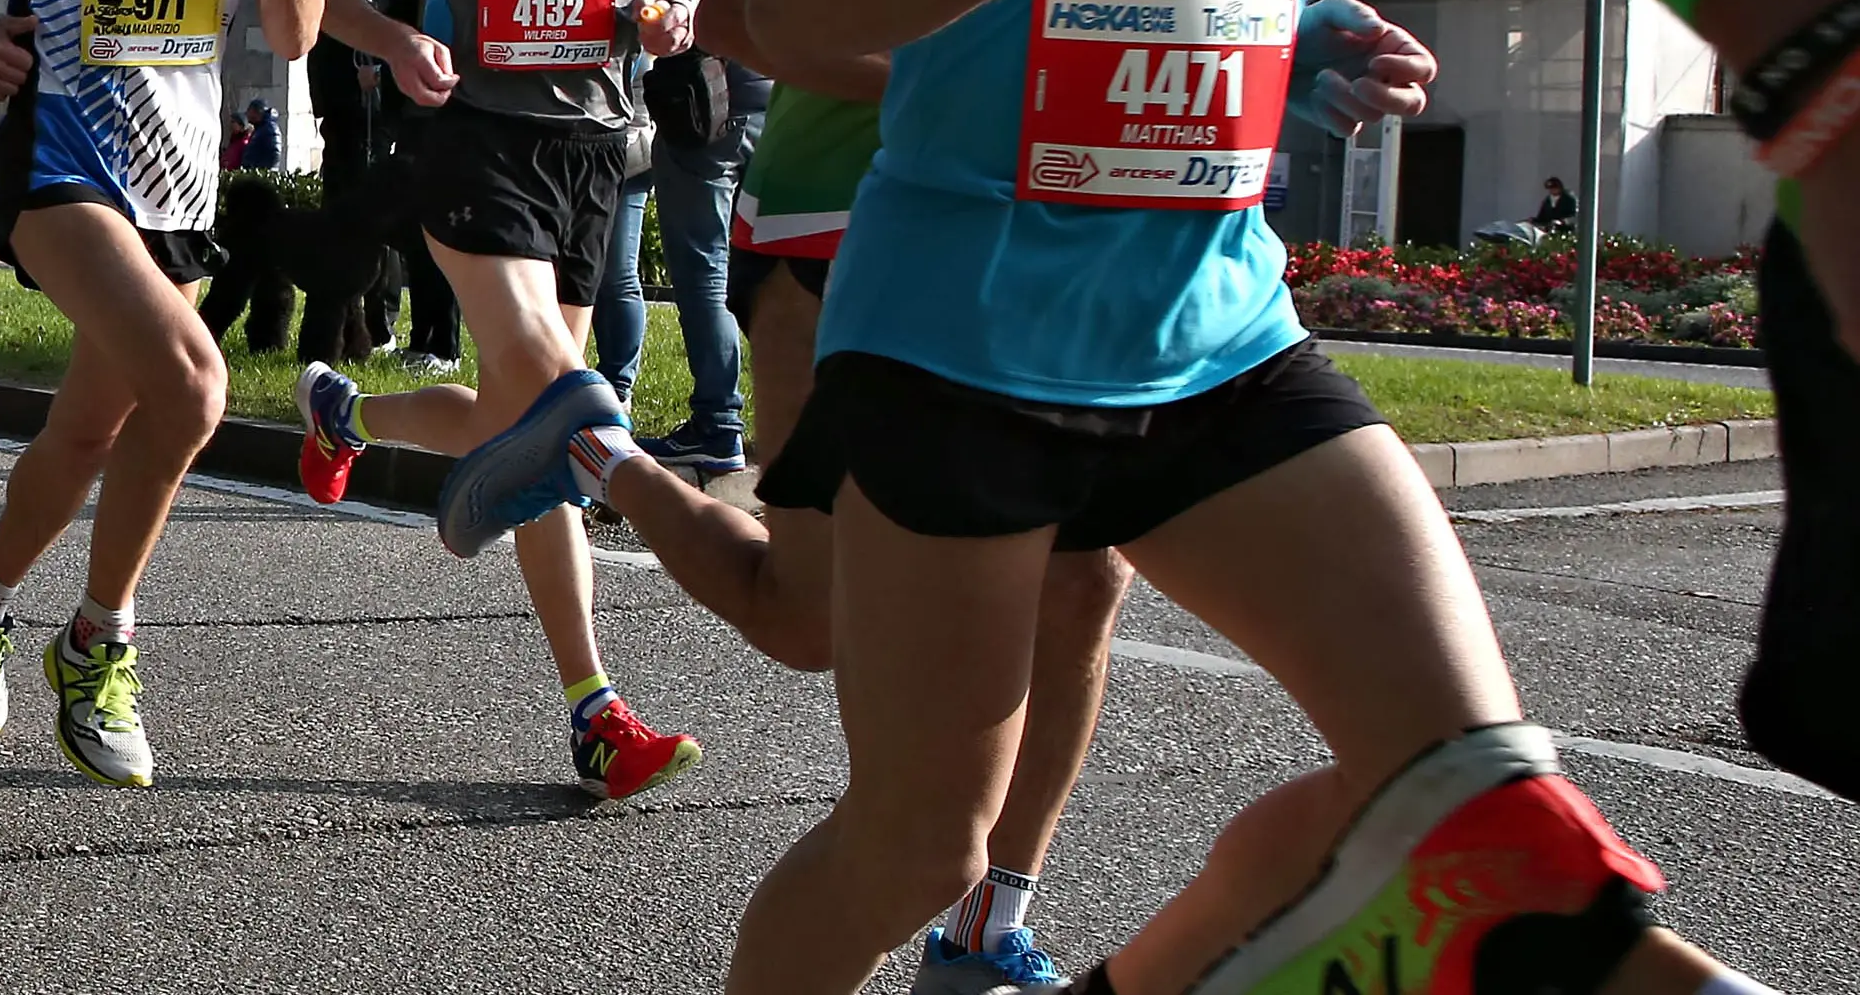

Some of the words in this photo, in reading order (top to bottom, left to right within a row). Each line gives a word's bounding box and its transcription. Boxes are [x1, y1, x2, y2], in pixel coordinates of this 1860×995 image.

[1048, 2, 1141, 32] HOKA
[1140, 6, 1175, 20] ONE
[132, 23, 181, 34] MAURIZIO
[524, 29, 568, 40] WILFRIED
[1140, 19, 1176, 34] ONE
[160, 39, 214, 58] Dryarn
[550, 44, 606, 62] Dryarn
[1105, 48, 1245, 118] 4471
[1119, 123, 1218, 145] MATTHIAS
[1108, 166, 1178, 181] arcese
